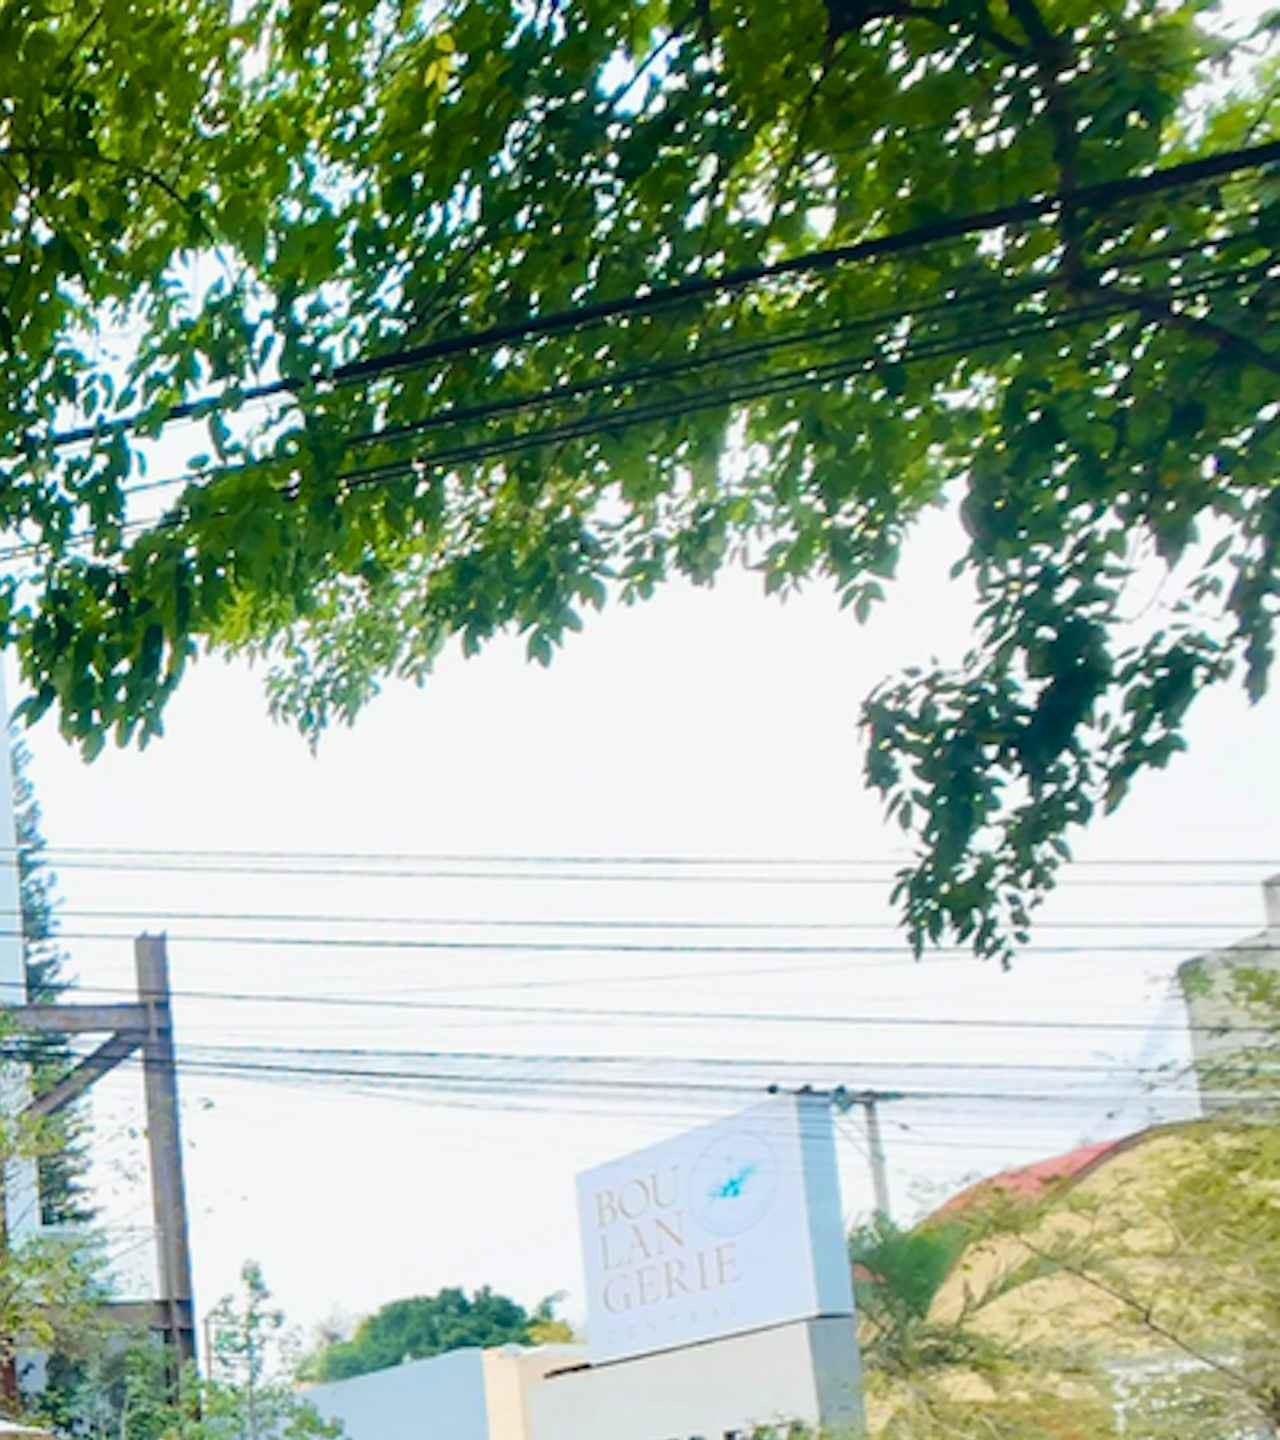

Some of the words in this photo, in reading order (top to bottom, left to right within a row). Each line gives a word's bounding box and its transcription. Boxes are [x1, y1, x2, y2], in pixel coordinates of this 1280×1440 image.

[594, 1164, 680, 1228] BOU
[600, 1211, 688, 1271] LAN
[602, 1241, 743, 1314] GERIE
